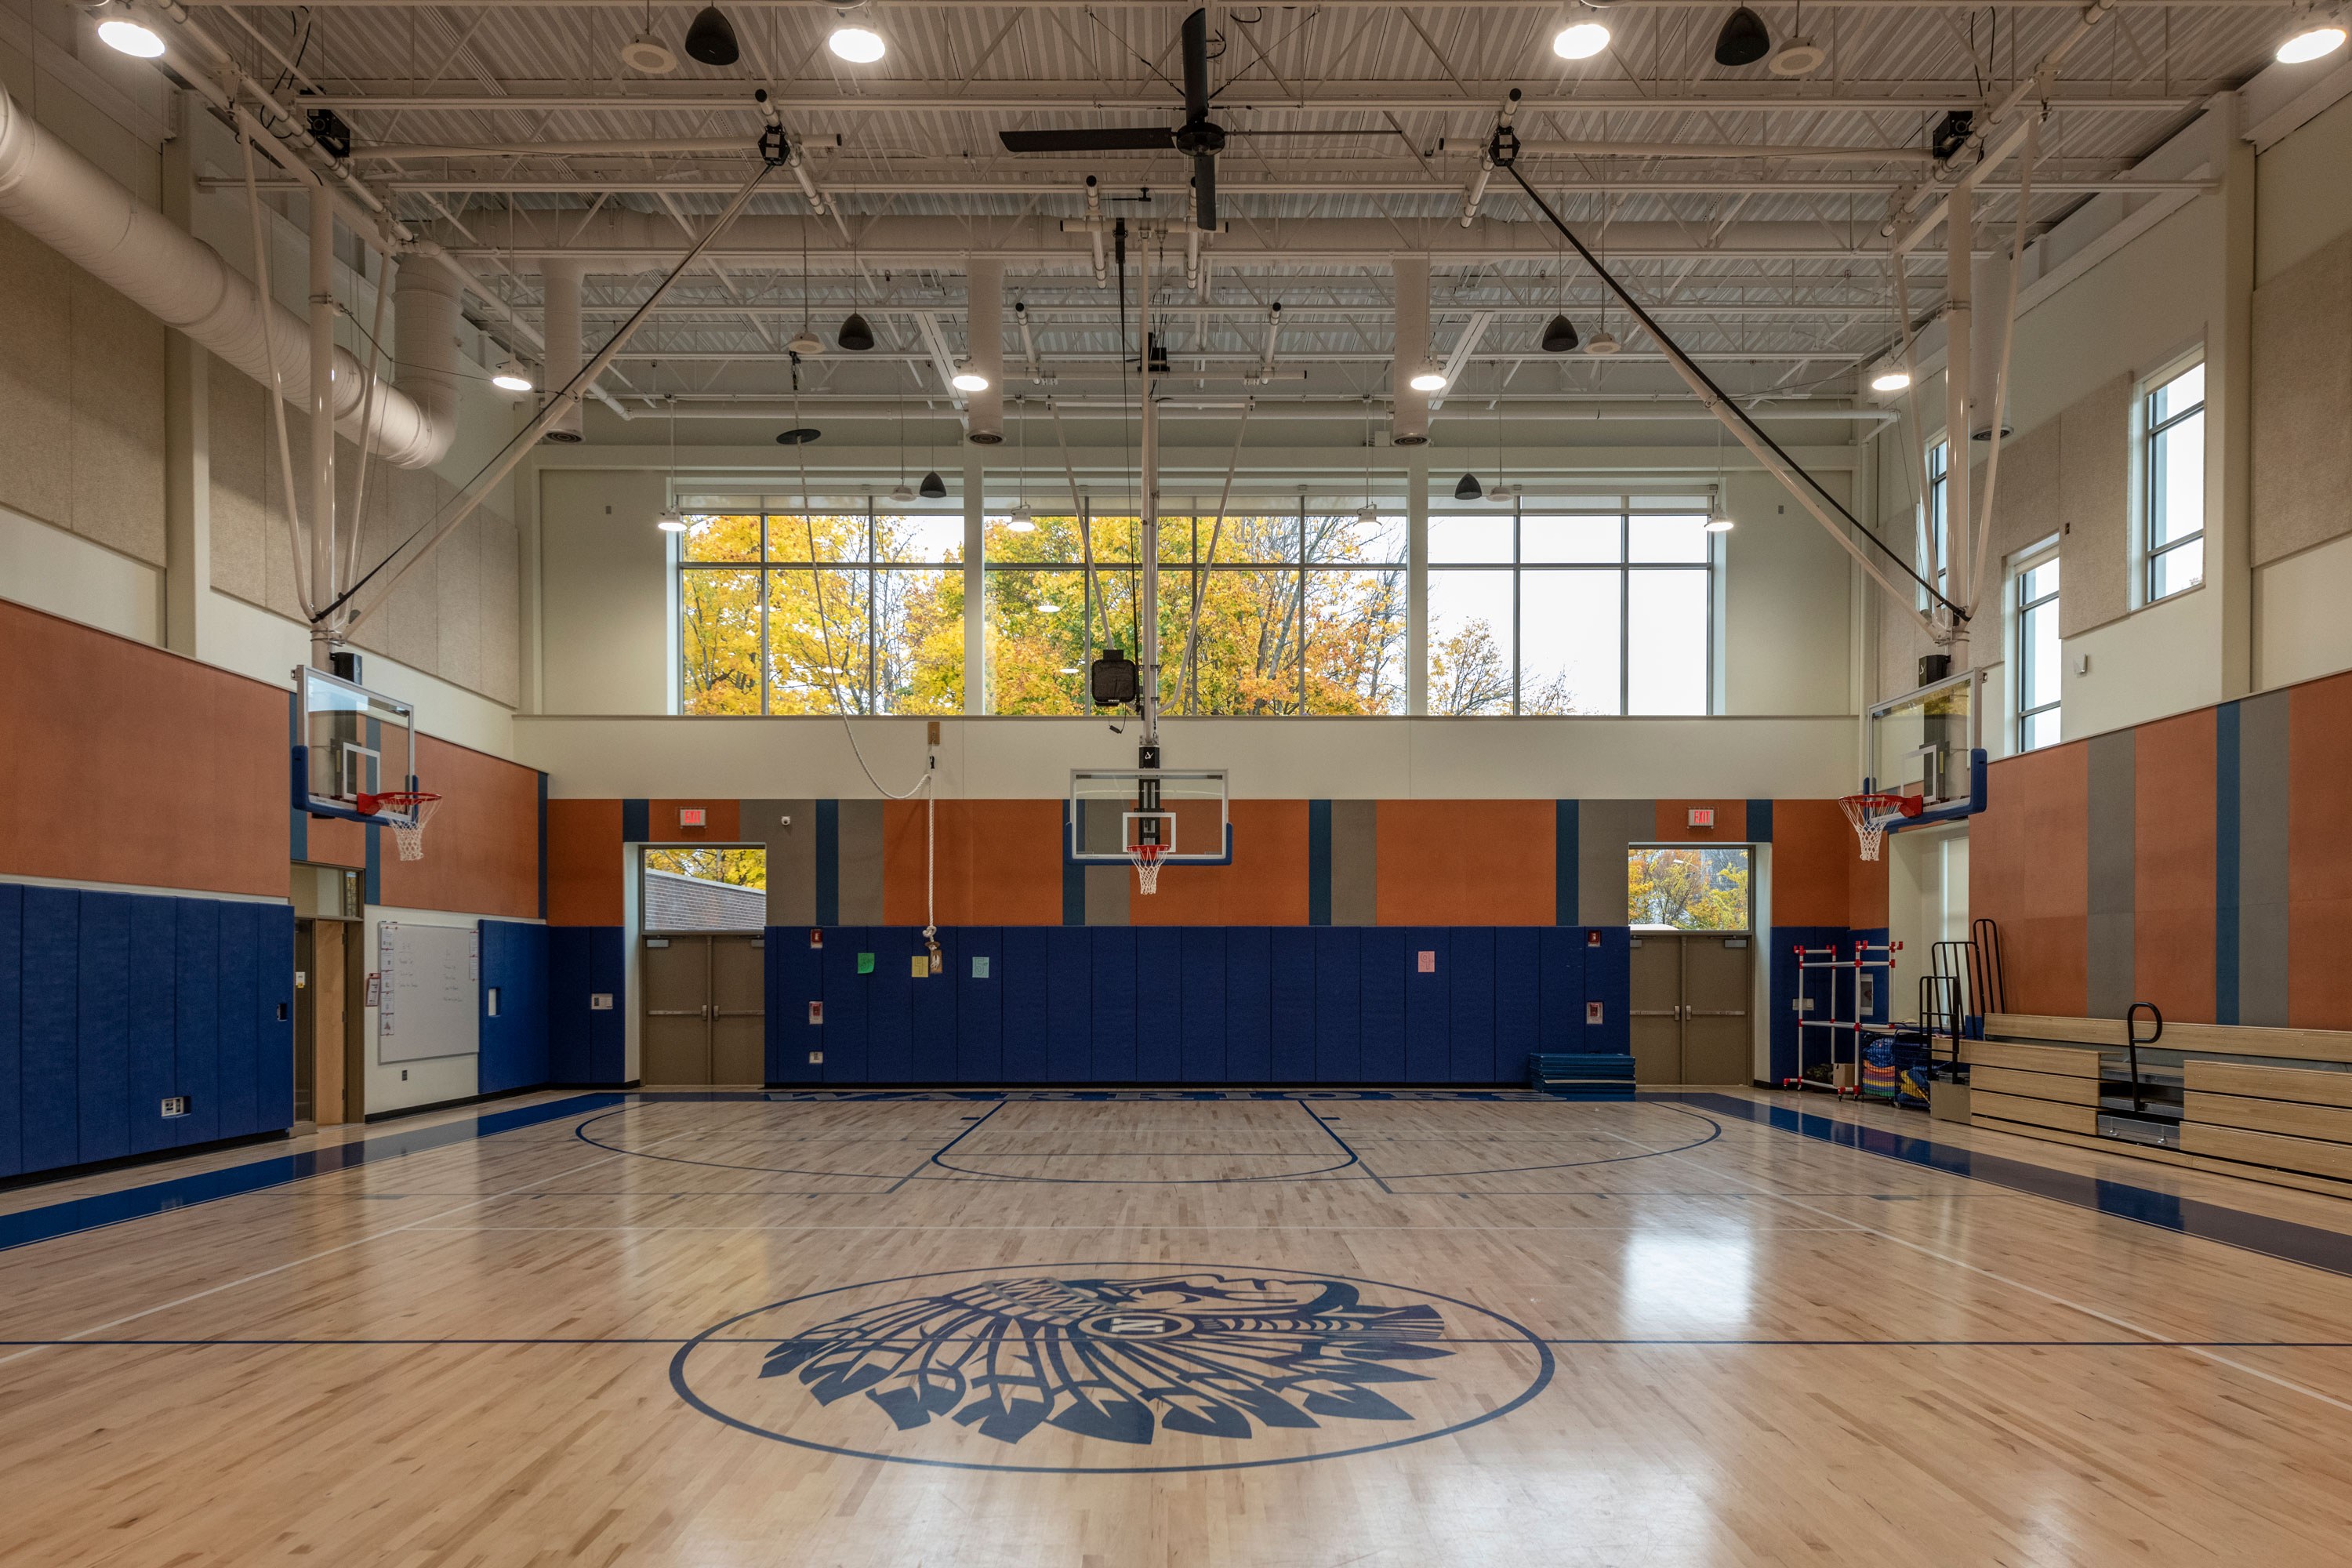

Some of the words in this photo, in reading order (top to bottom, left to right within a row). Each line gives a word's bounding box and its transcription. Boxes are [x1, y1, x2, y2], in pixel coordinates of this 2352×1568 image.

[684, 811, 702, 823] EXIT
[1694, 811, 1710, 823] EXIT
[761, 1092, 1567, 1101] WARRIORS
